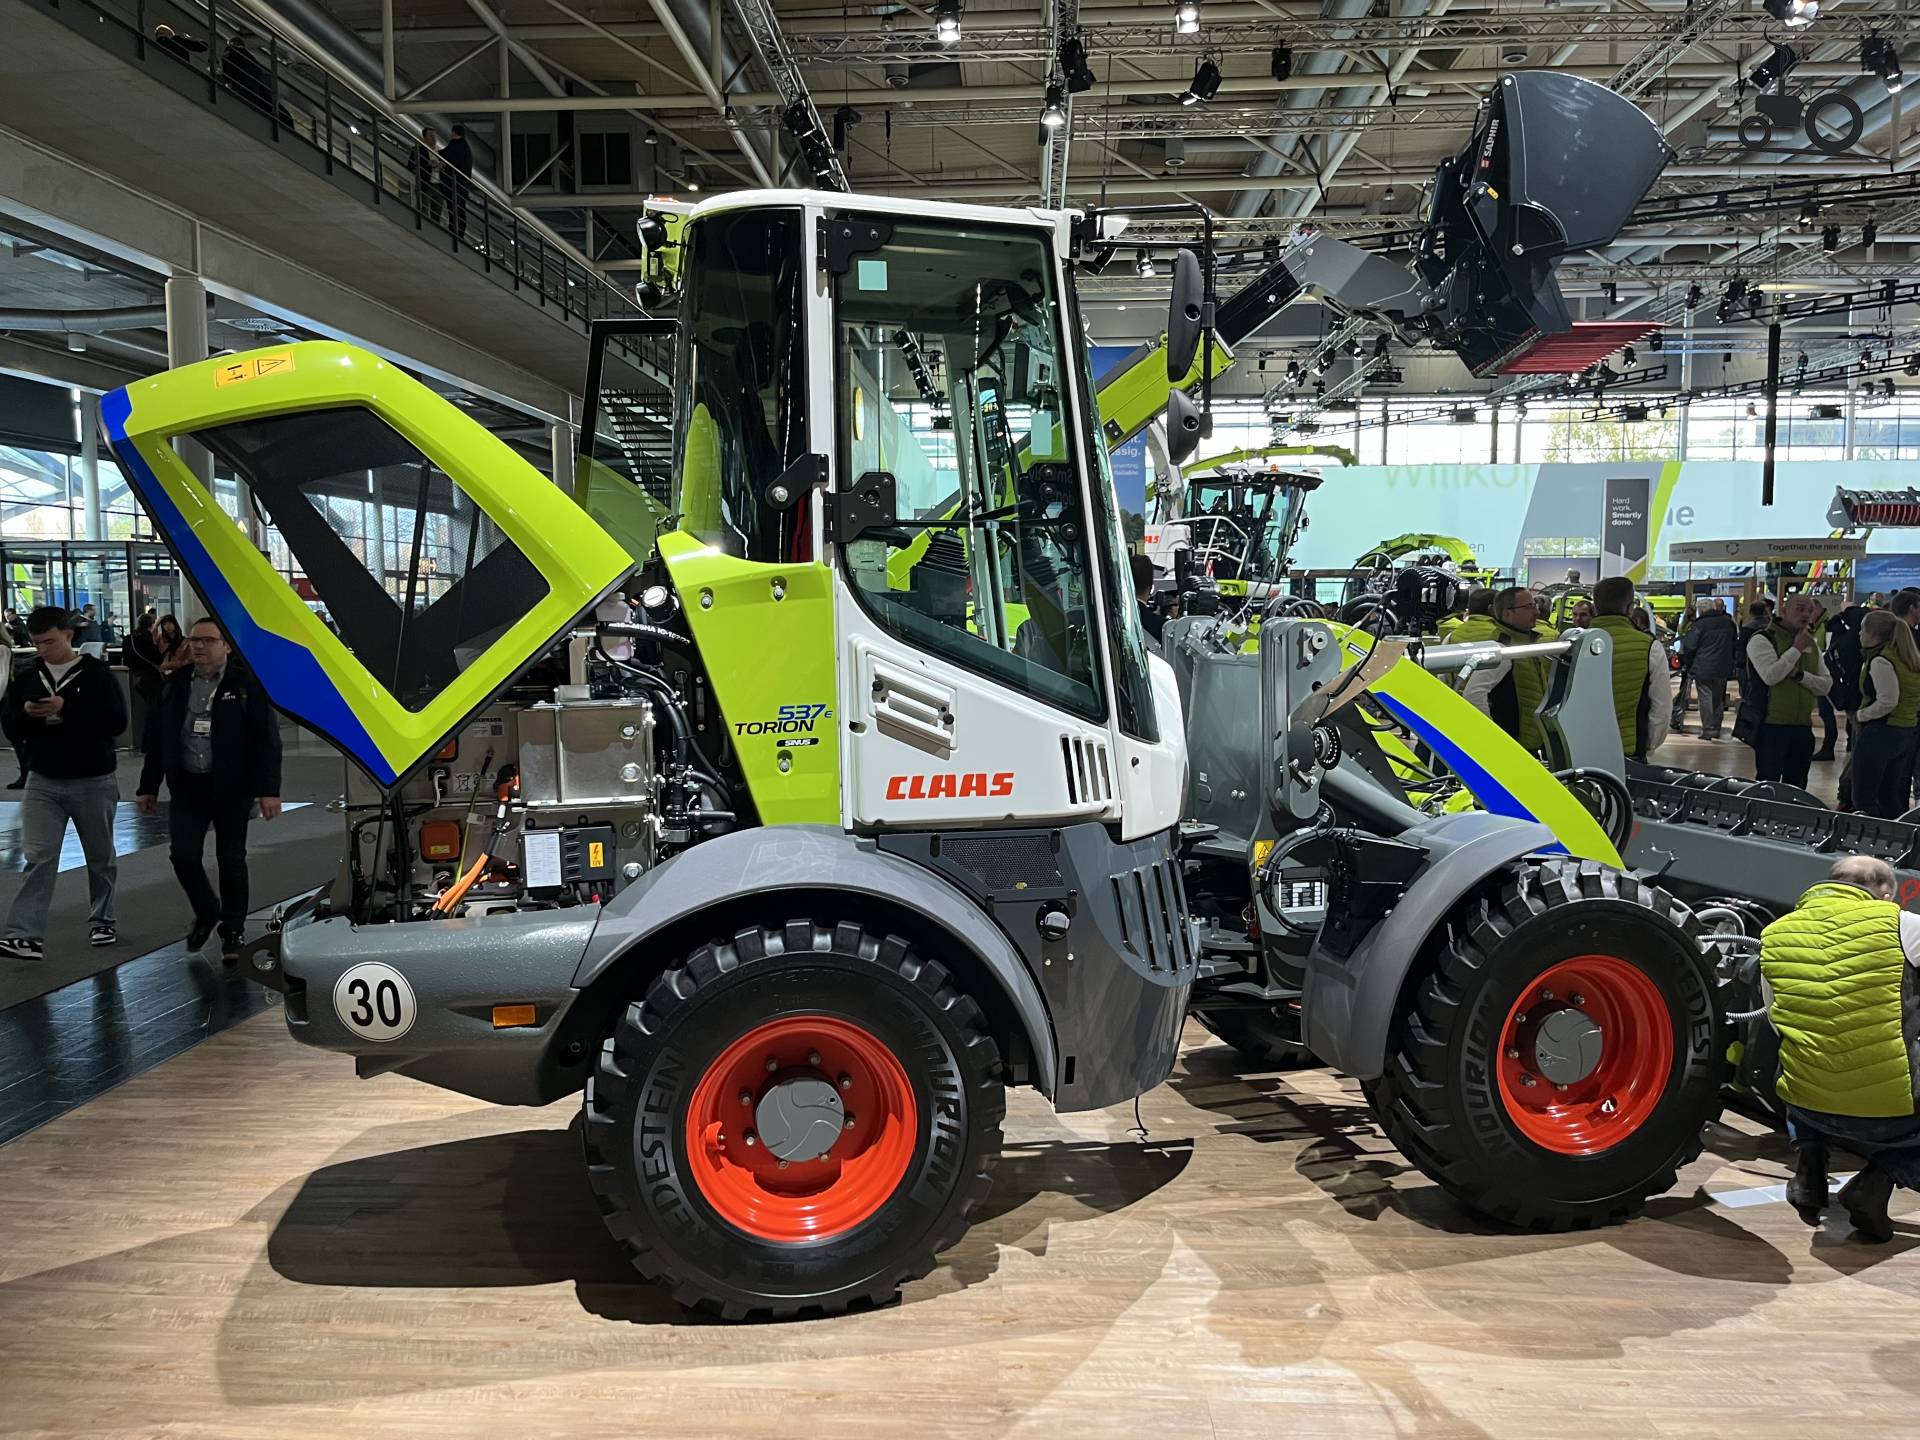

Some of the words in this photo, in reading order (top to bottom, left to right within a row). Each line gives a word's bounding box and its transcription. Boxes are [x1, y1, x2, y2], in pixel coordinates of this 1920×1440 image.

[1484, 119, 1500, 157] SAPHIR
[1612, 497, 1630, 505] Hard
[1611, 511, 1642, 520] Smartly
[1611, 519, 1634, 527] done.
[1767, 543, 1808, 552] Together
[1809, 543, 1822, 551] the
[734, 719, 815, 736] TORION
[784, 738, 811, 747] SINUS
[885, 772, 1015, 801] CLAAS
[347, 978, 402, 1028] 30
